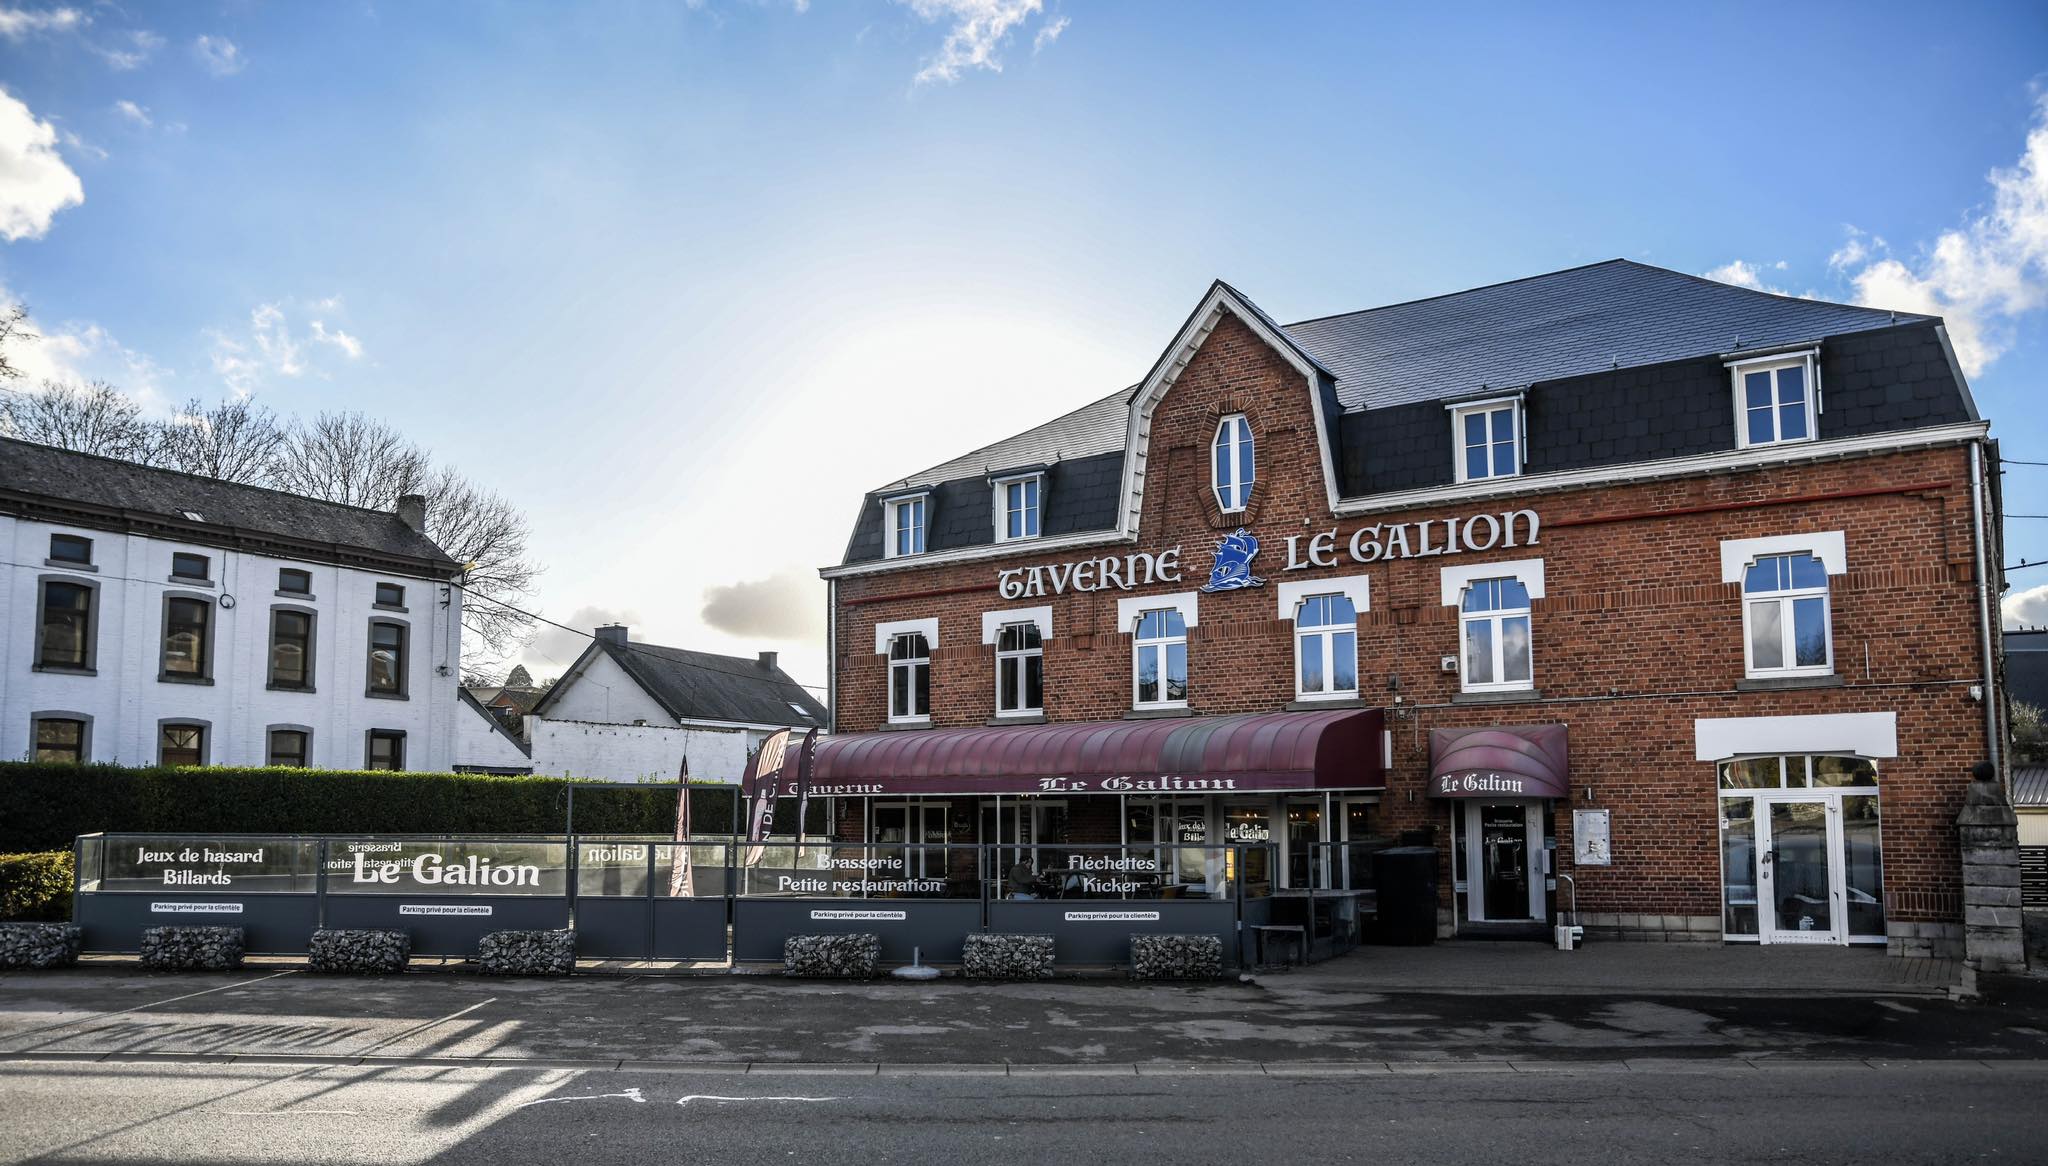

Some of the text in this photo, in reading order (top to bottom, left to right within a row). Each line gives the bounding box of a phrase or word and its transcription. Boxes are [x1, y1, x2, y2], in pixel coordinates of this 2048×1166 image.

[1283, 509, 1540, 571] LE GALION
[998, 545, 1181, 599] TAVERNE
[1039, 776, 1236, 791] Le Galion
[1441, 773, 1522, 793] Le Galion
[136, 847, 263, 864] Jeux de hasard
[817, 854, 903, 869] Brasserie
[1068, 855, 1155, 870] Fléchettes
[163, 869, 231, 885] Billards
[353, 853, 539, 886] Le Galion
[778, 876, 941, 892] Petite restauration
[1083, 877, 1140, 893] Kicker
[154, 903, 177, 911] Parking
[402, 906, 426, 914] Parking
